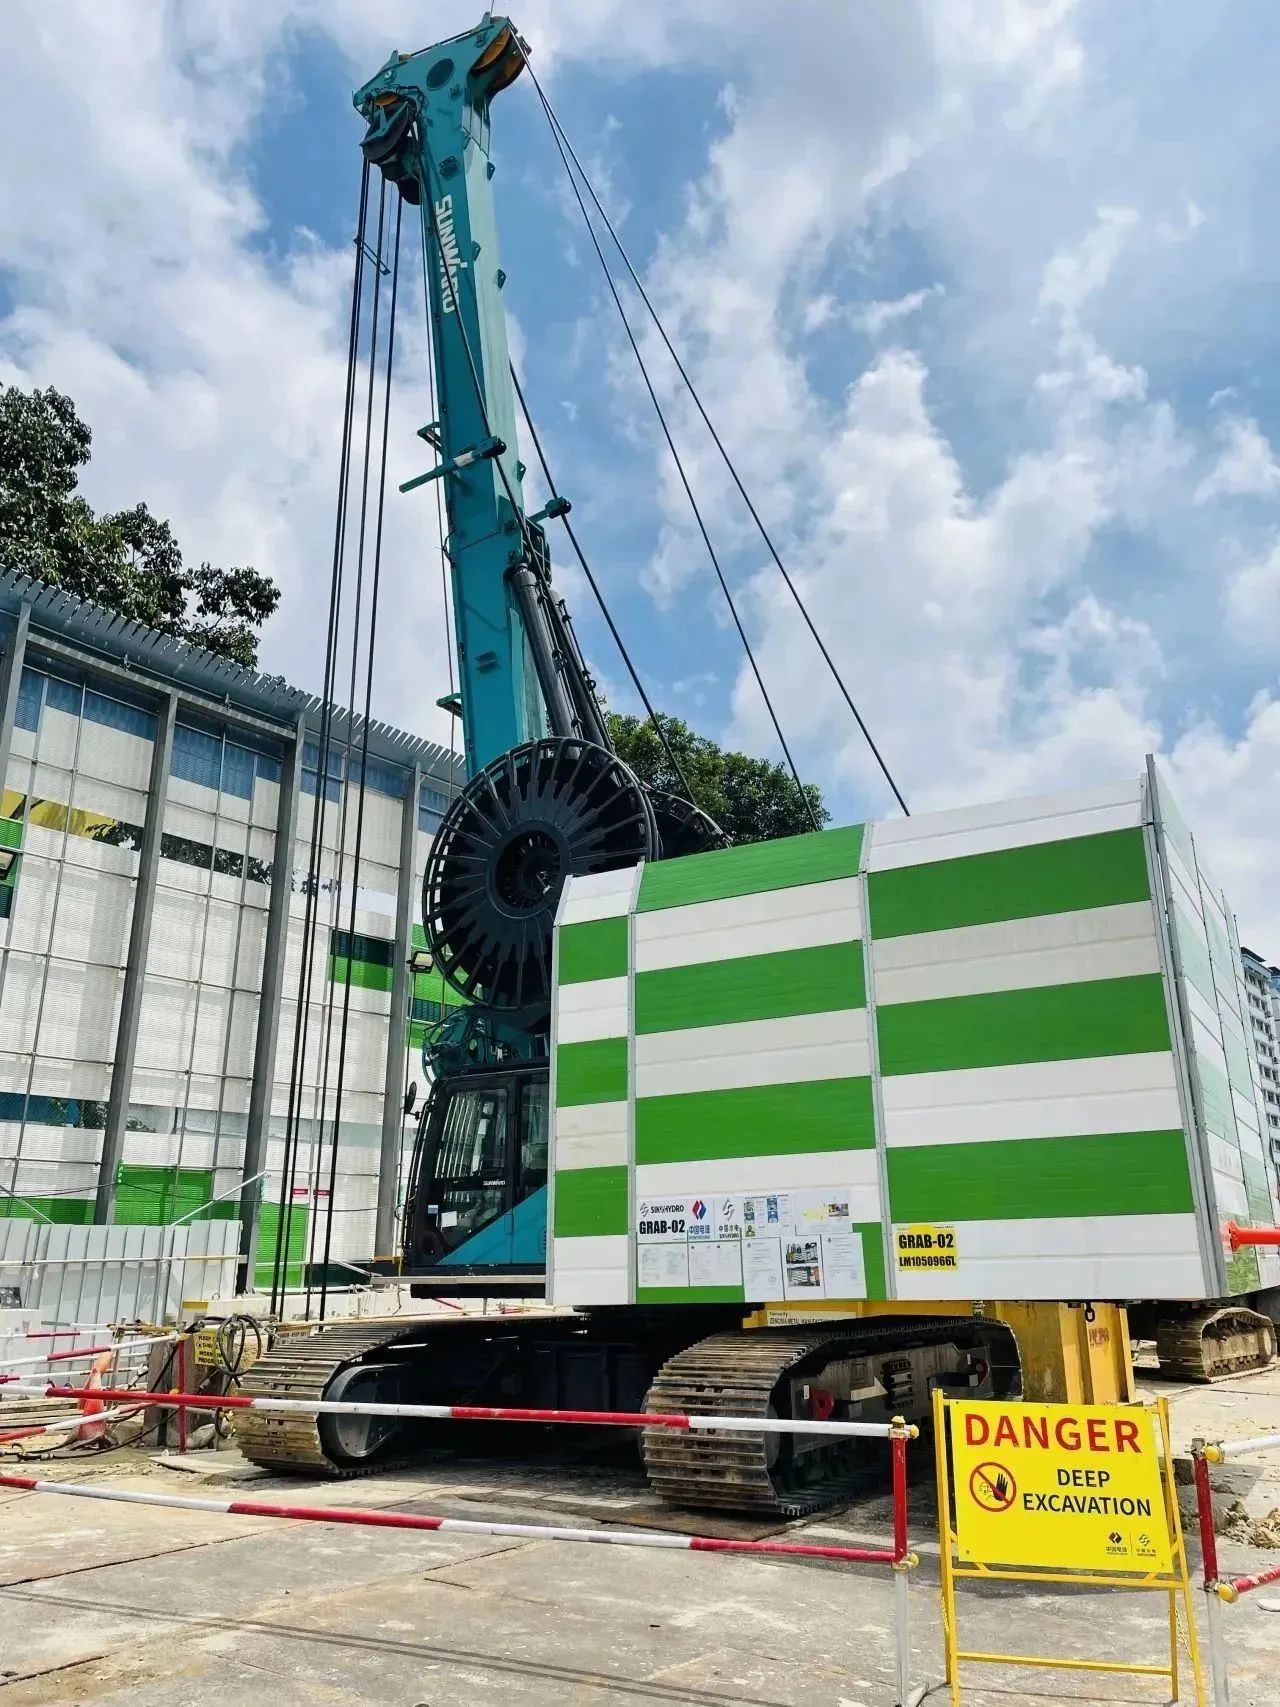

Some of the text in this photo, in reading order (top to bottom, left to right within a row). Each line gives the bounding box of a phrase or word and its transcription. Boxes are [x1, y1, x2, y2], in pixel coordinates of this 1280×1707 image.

[650, 1204, 684, 1214] SINOHYDRO
[639, 1219, 685, 1235] GRAB-02
[898, 1233, 954, 1249] GRAB-02
[965, 1413, 1142, 1453] DANGER
[1057, 1468, 1110, 1488] DEEP
[1023, 1492, 1152, 1517] EXCAVATION
